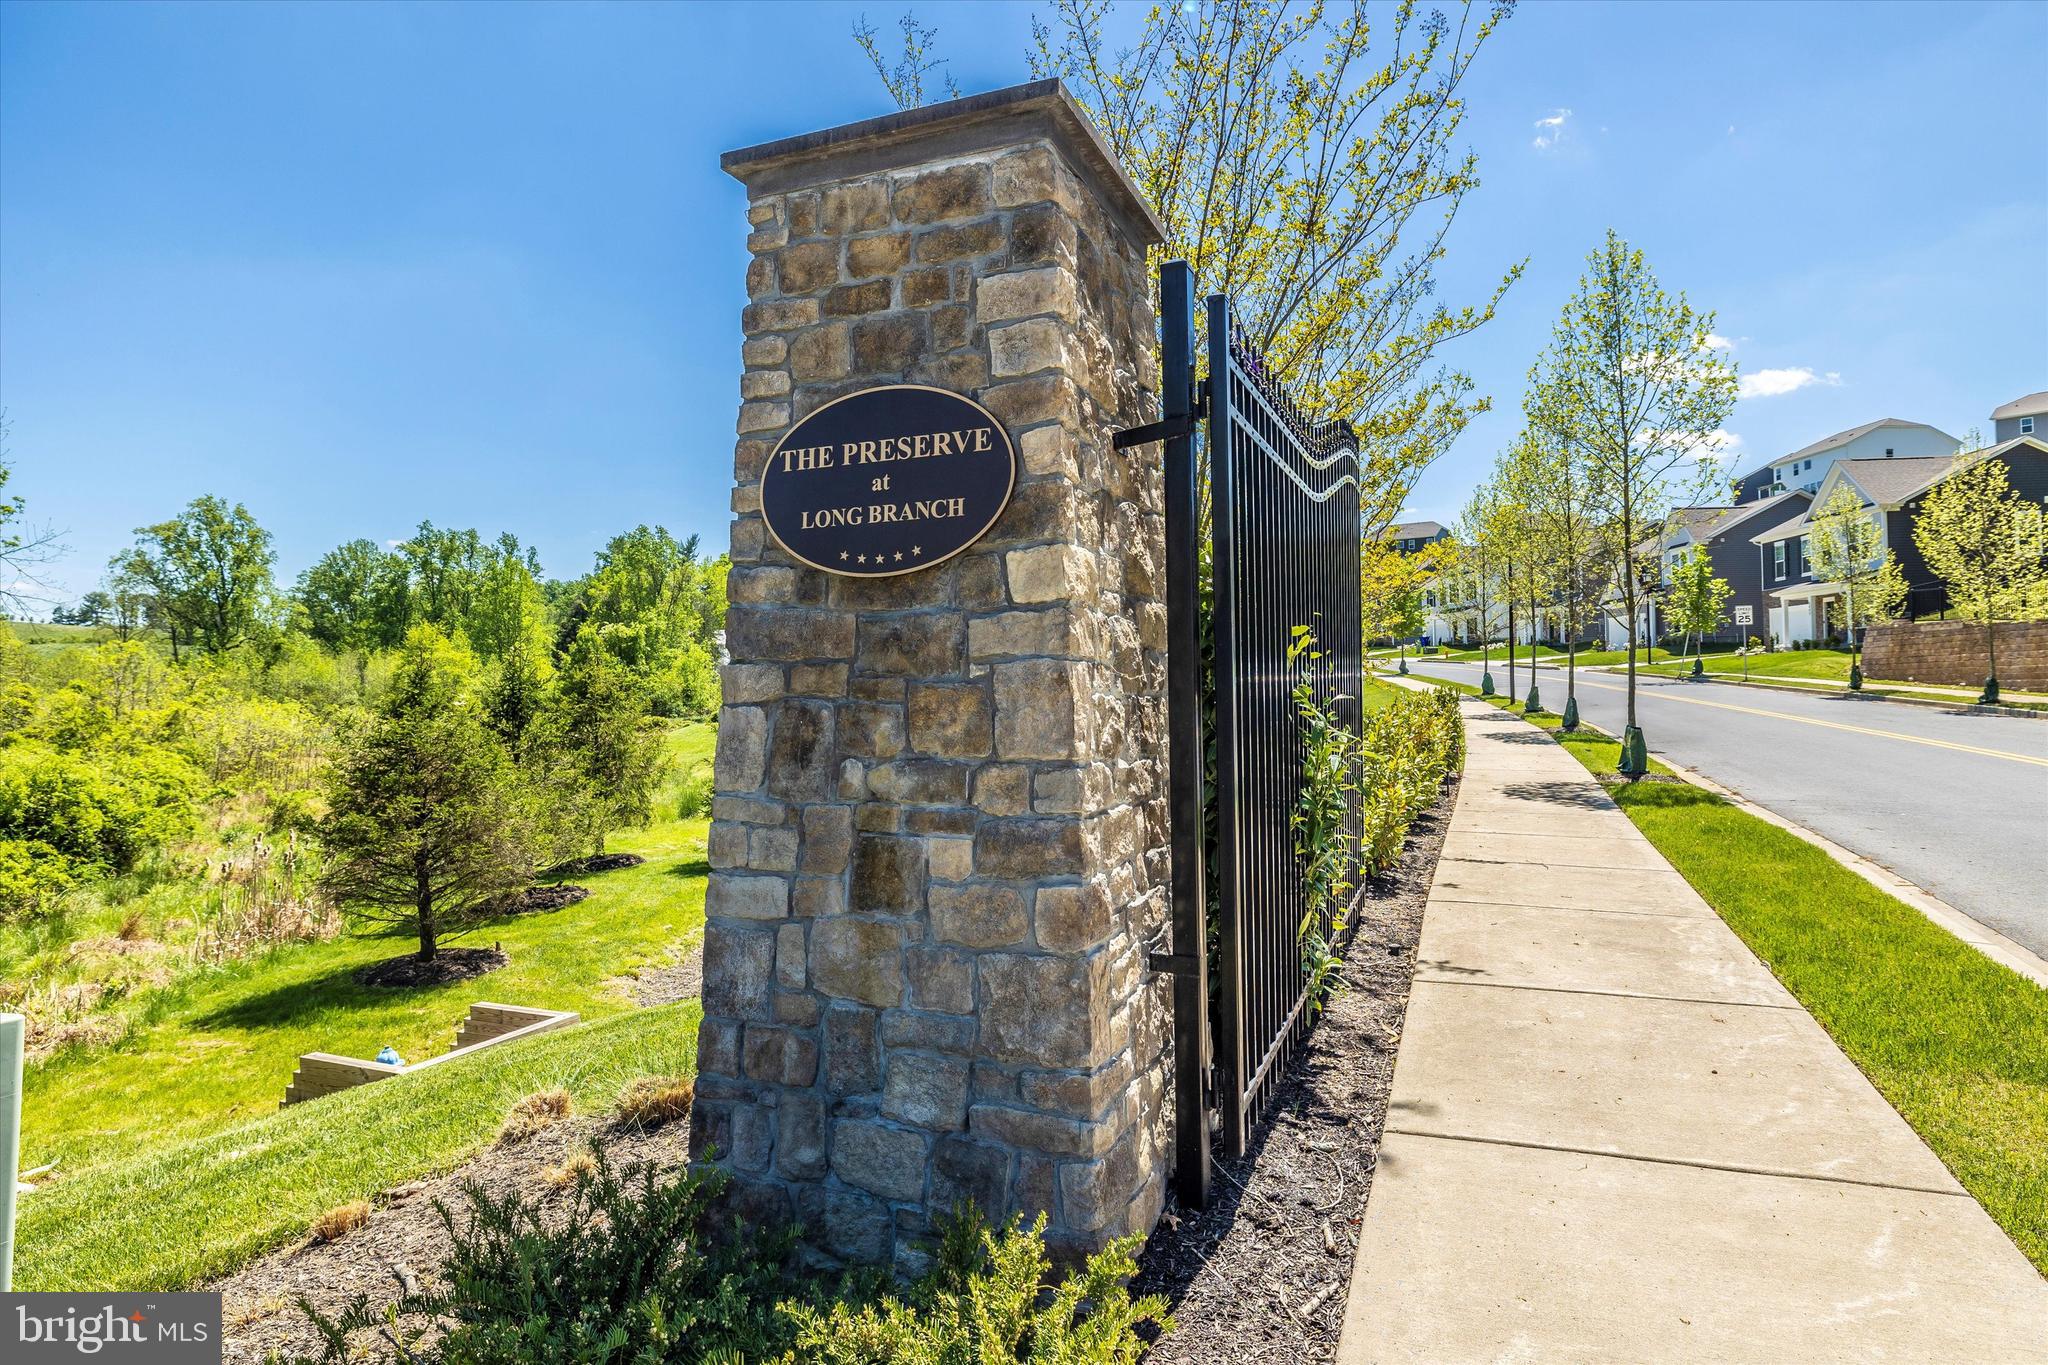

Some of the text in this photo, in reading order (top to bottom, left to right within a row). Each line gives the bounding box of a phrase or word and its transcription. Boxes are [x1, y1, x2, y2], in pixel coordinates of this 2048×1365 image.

[779, 428, 993, 472] THE PRESERVE
[871, 474, 890, 492] at
[801, 497, 966, 530] LONG BRANCH
[1738, 615, 1751, 623] 25
